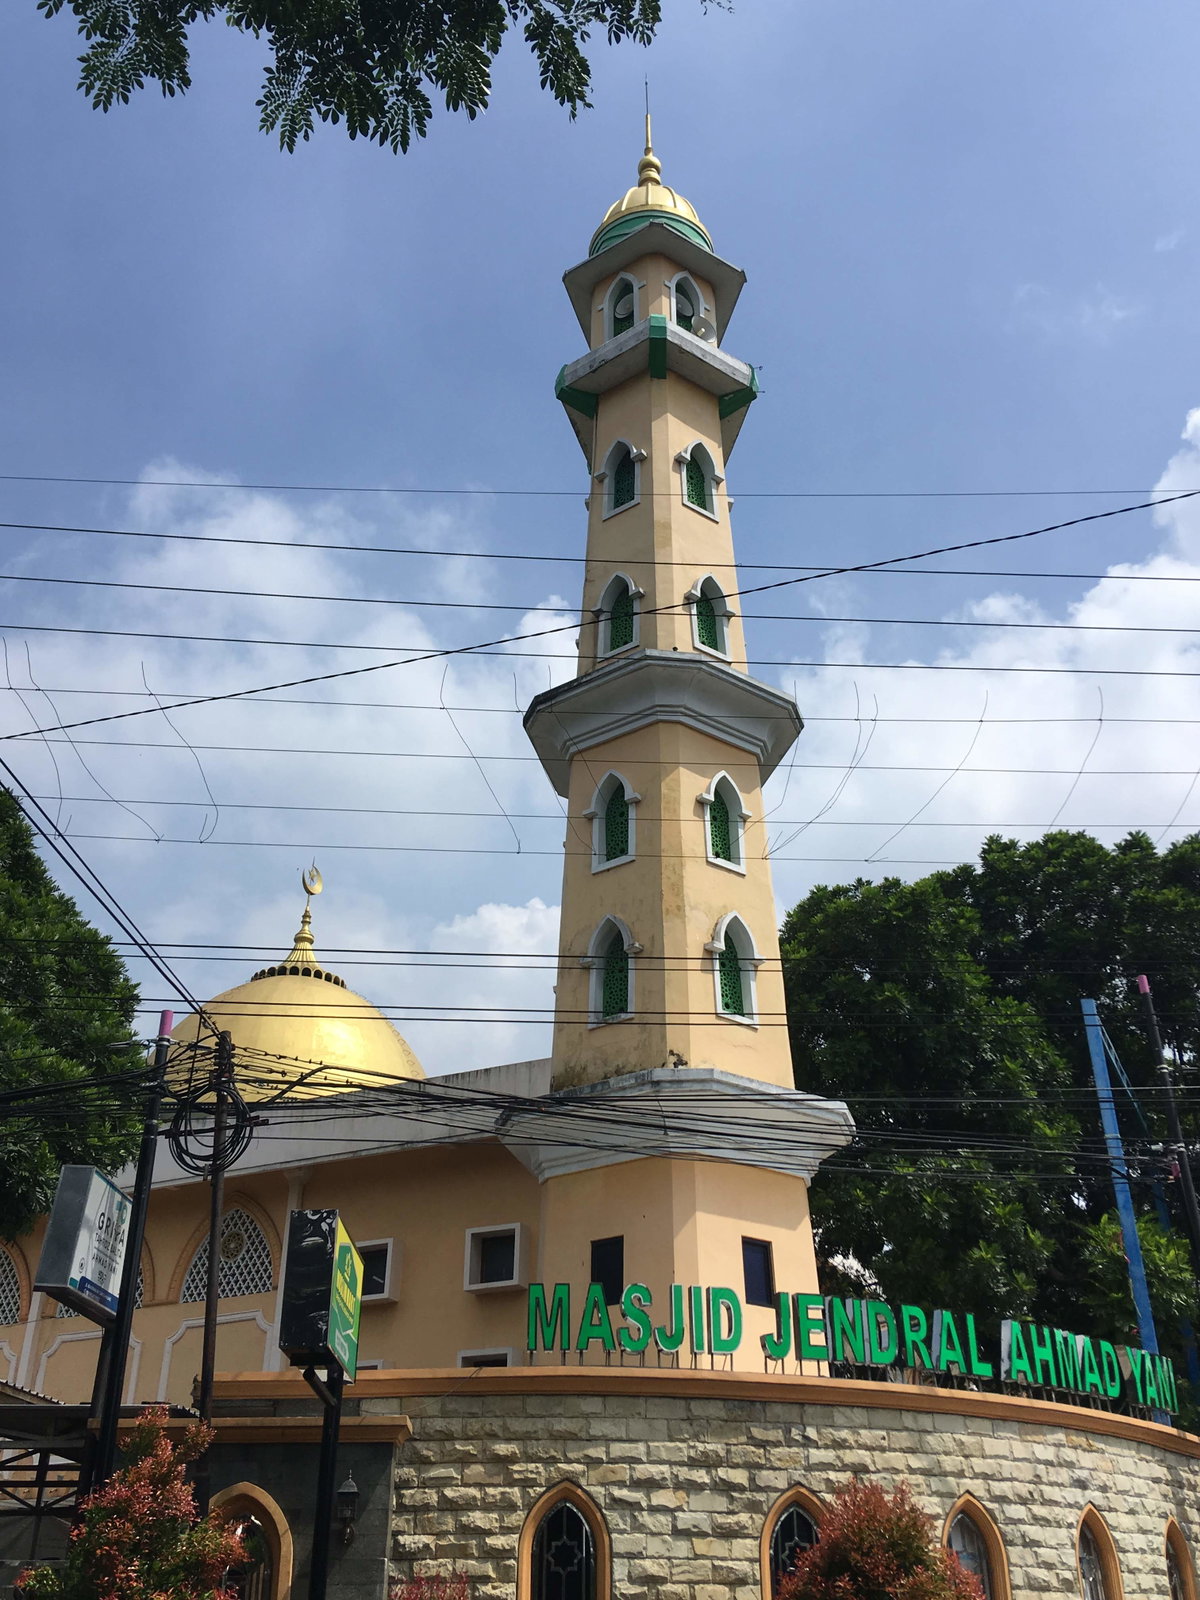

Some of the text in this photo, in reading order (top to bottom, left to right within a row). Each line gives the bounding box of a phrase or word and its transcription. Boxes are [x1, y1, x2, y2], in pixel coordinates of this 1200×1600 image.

[97, 1212, 125, 1248] GRIYA
[527, 1283, 1180, 1415] MASJID JENDRAL AHMAD YANI
